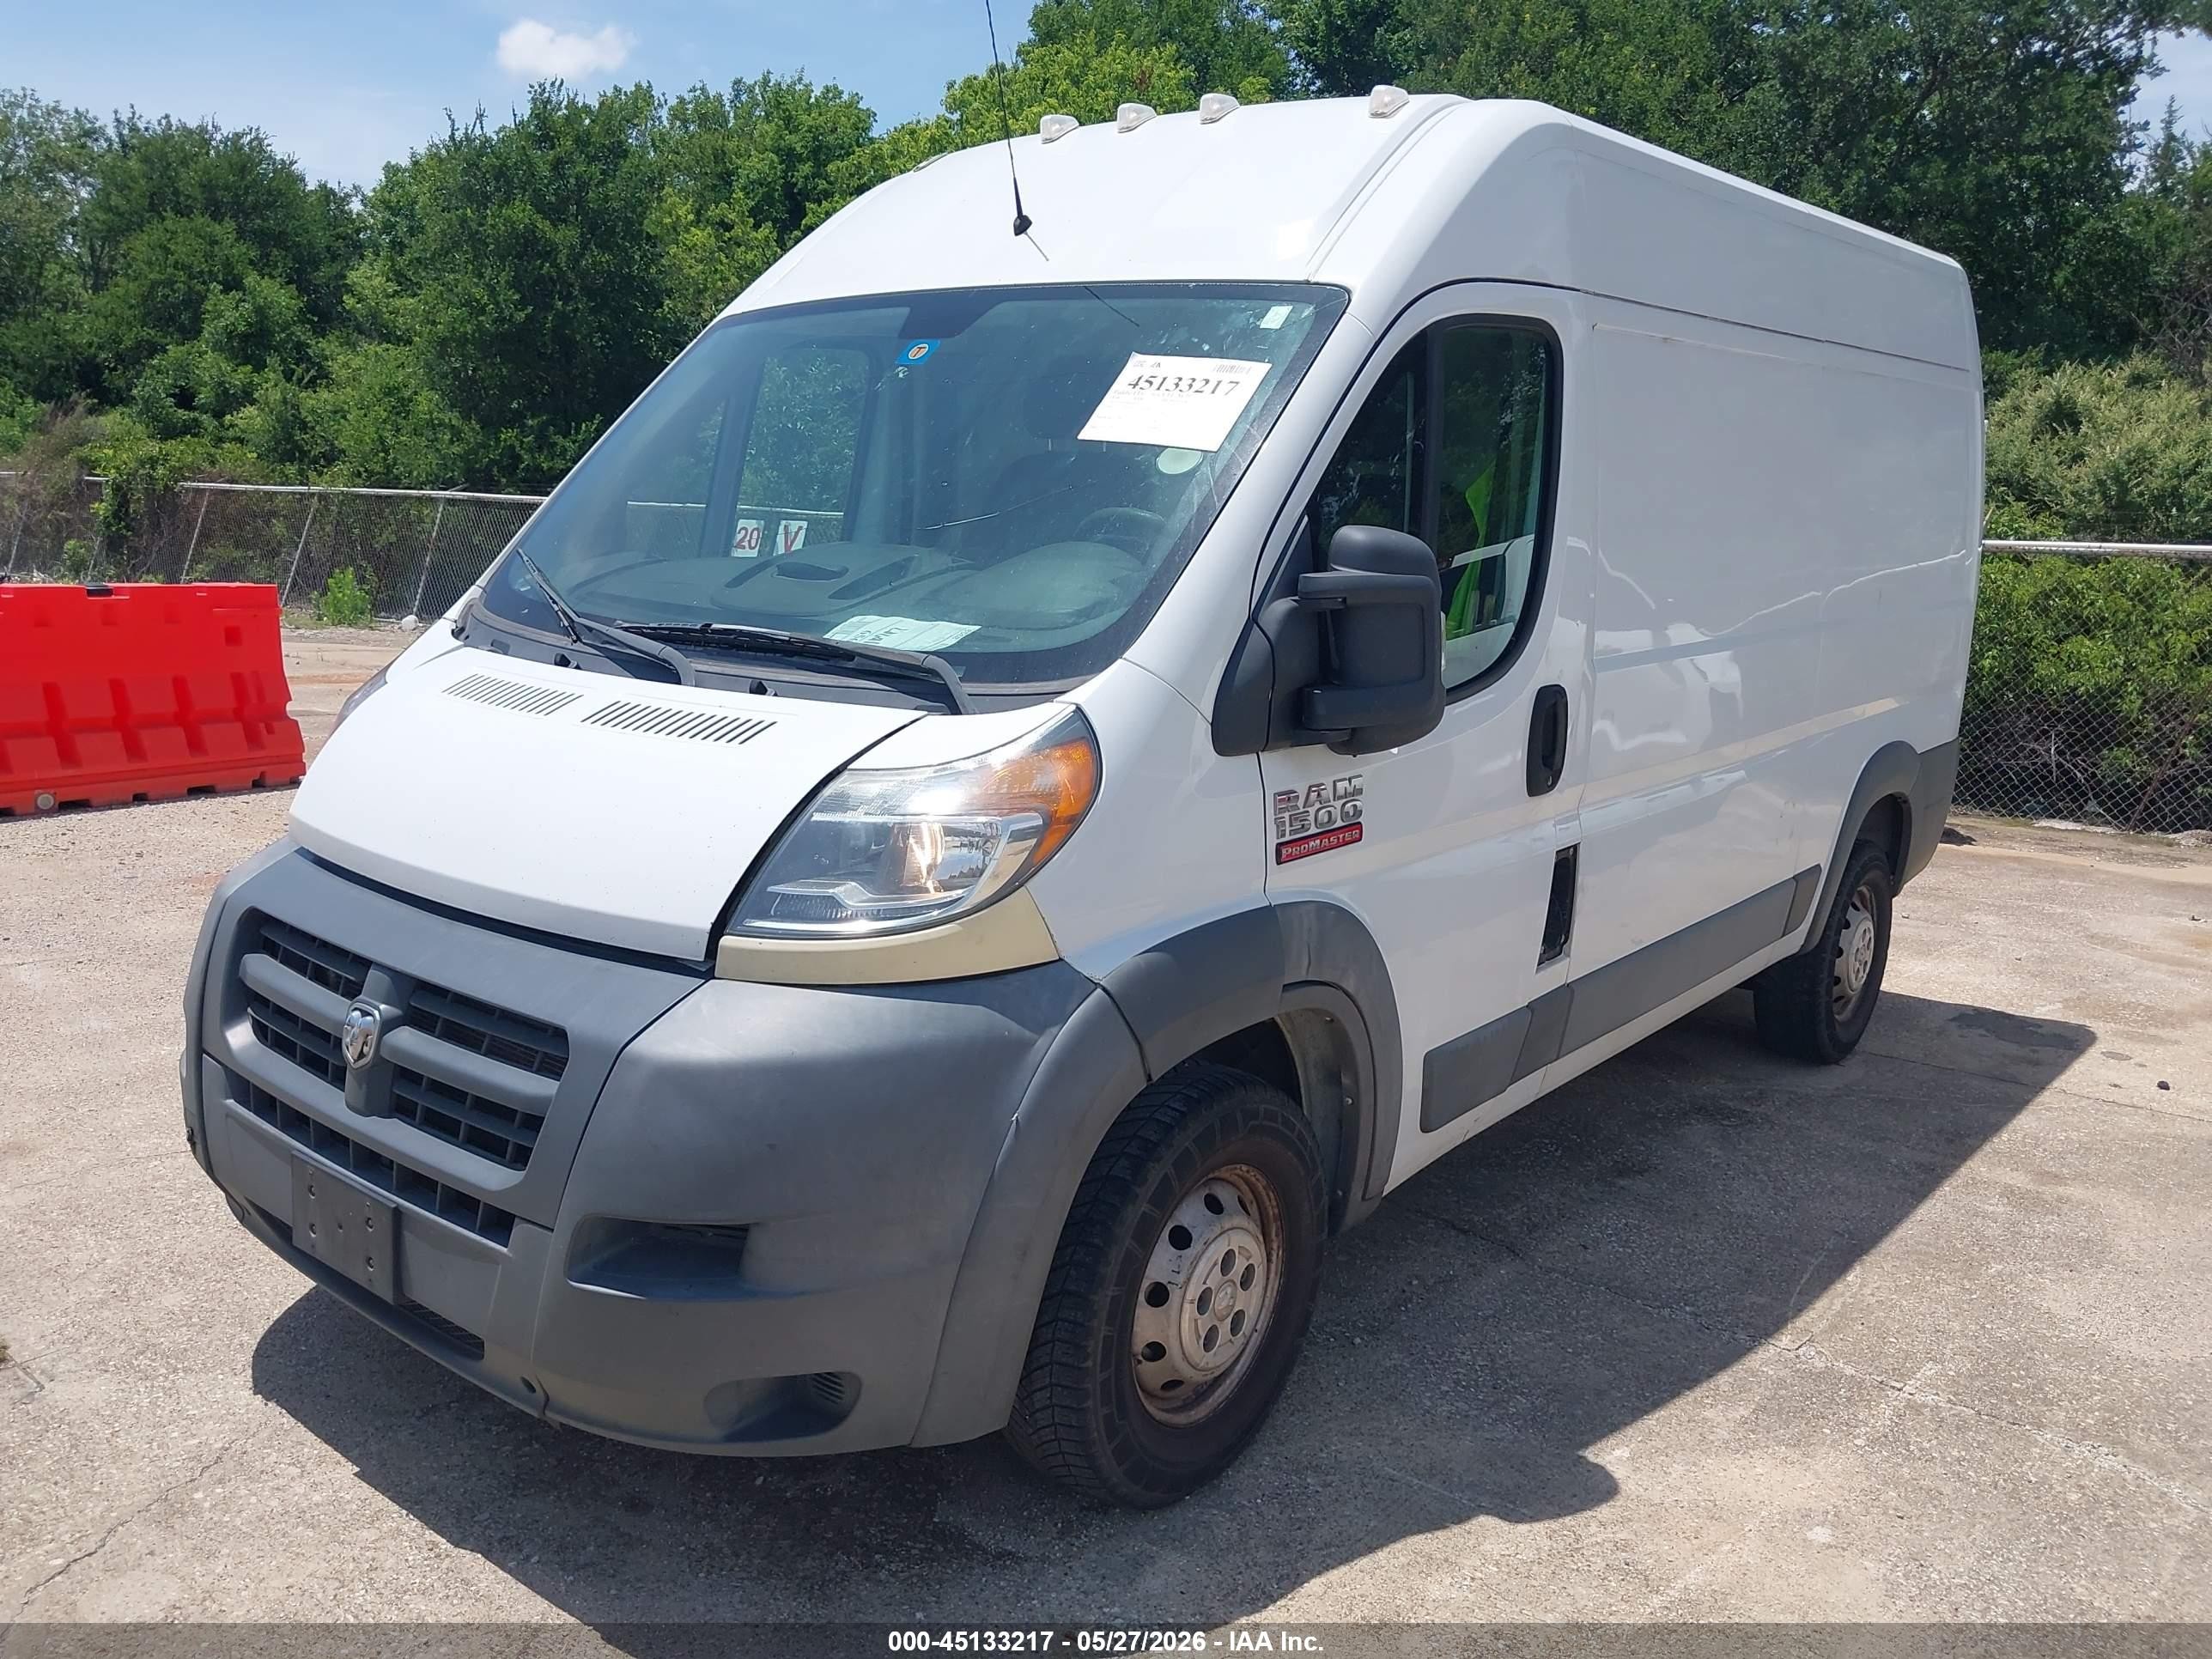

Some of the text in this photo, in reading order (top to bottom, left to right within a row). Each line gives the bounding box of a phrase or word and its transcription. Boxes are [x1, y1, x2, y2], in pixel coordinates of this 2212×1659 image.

[1127, 374, 1241, 396] 45133217
[734, 526, 761, 550] 20
[784, 523, 804, 553] V
[1273, 774, 1364, 816] RAM
[1273, 799, 1364, 839] 1500
